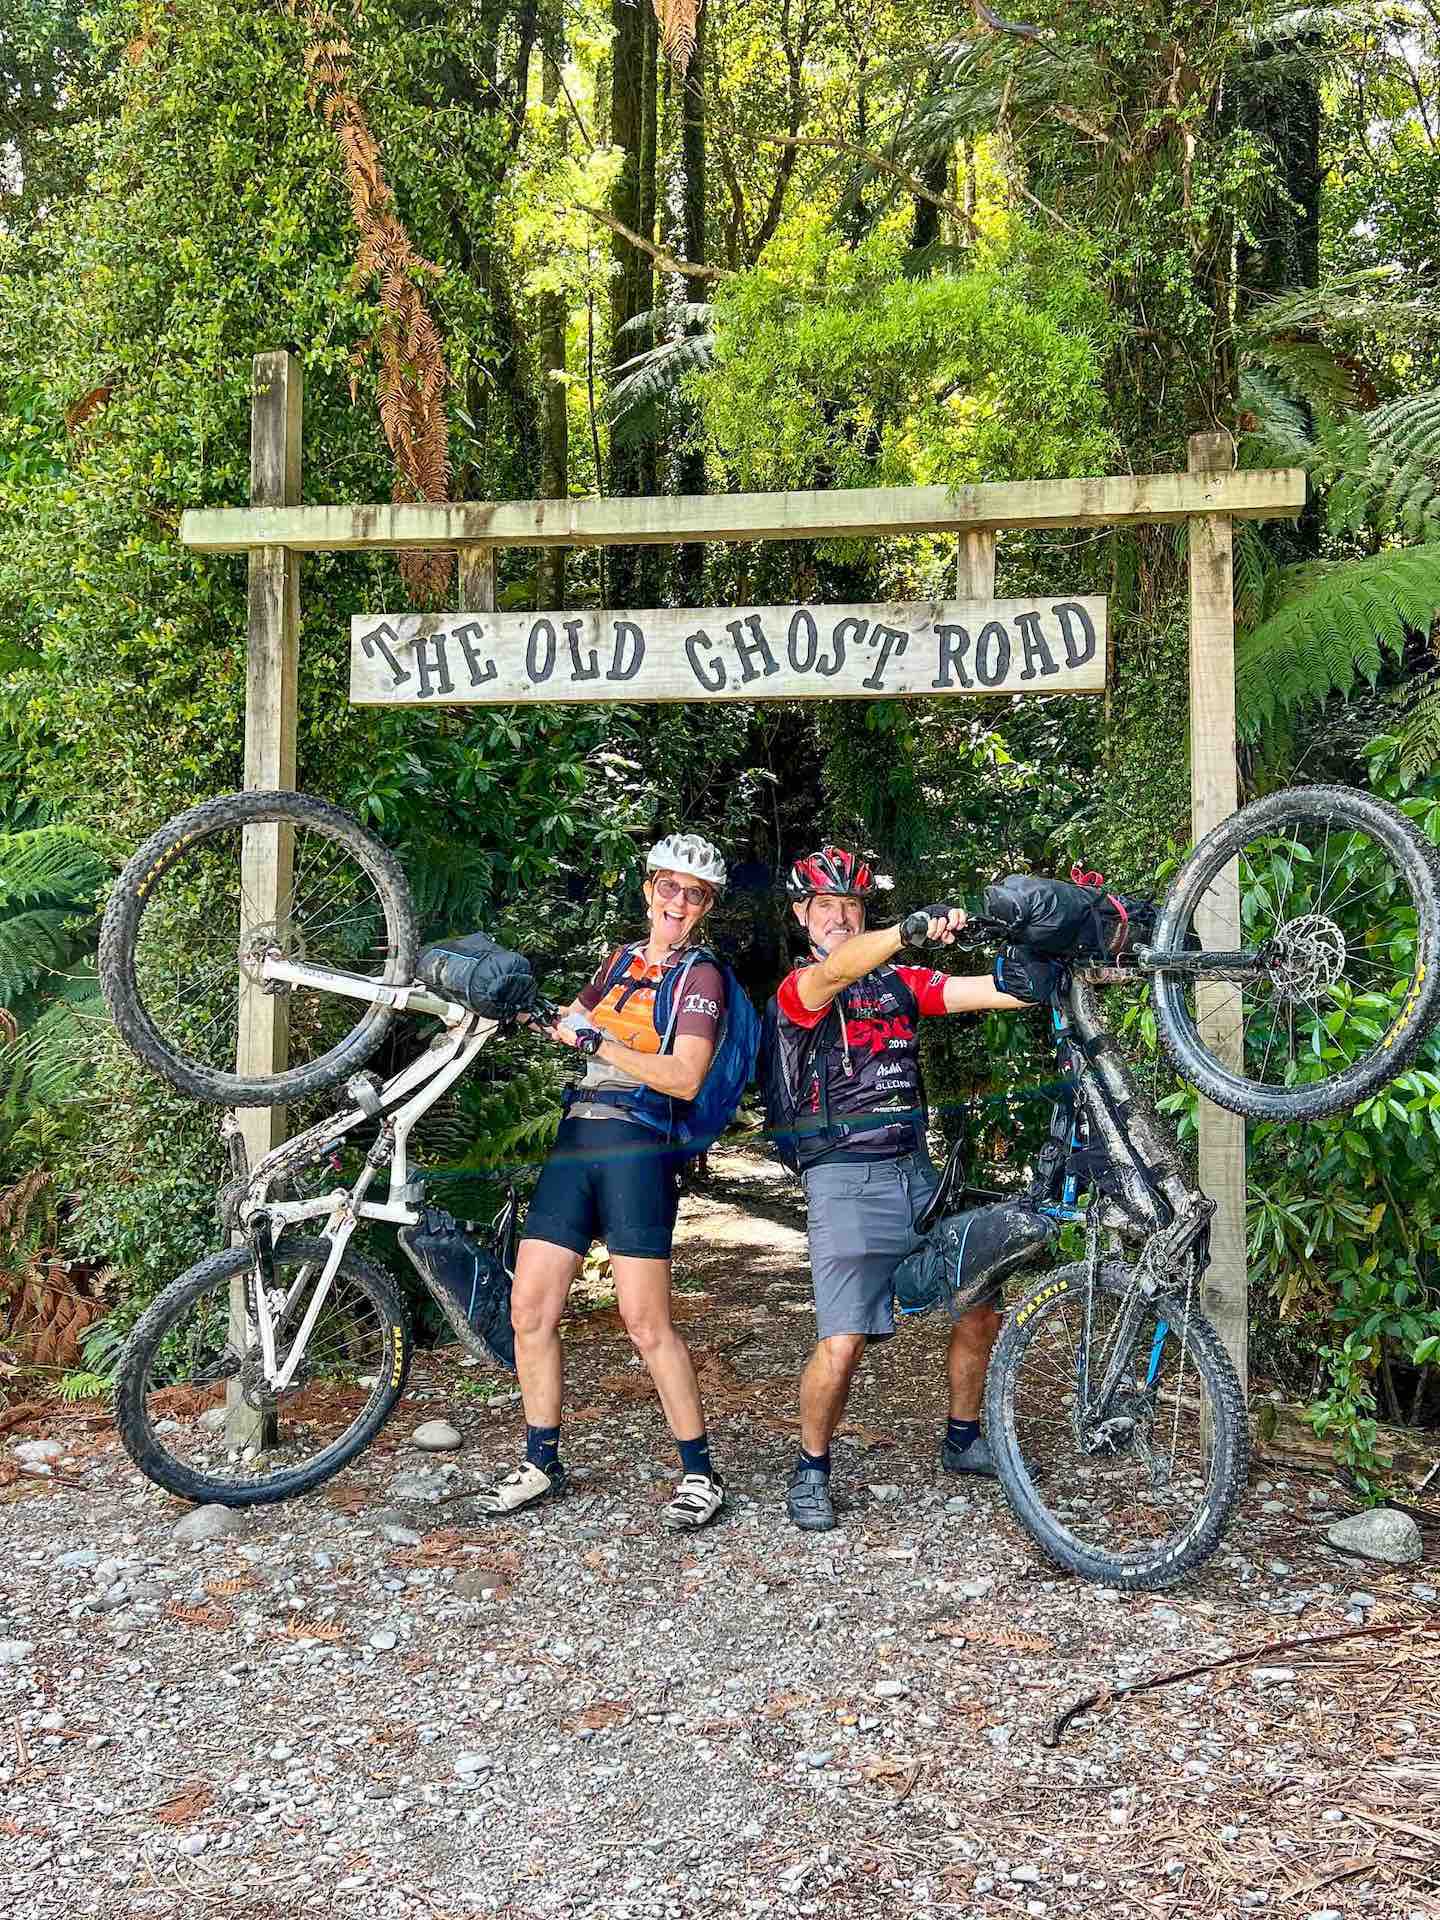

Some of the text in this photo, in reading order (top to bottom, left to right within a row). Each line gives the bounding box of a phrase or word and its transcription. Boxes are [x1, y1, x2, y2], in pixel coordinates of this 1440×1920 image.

[361, 602, 1097, 698] THE OLD GHOST ROAD
[1016, 1280, 1068, 1325] MAXXIS
